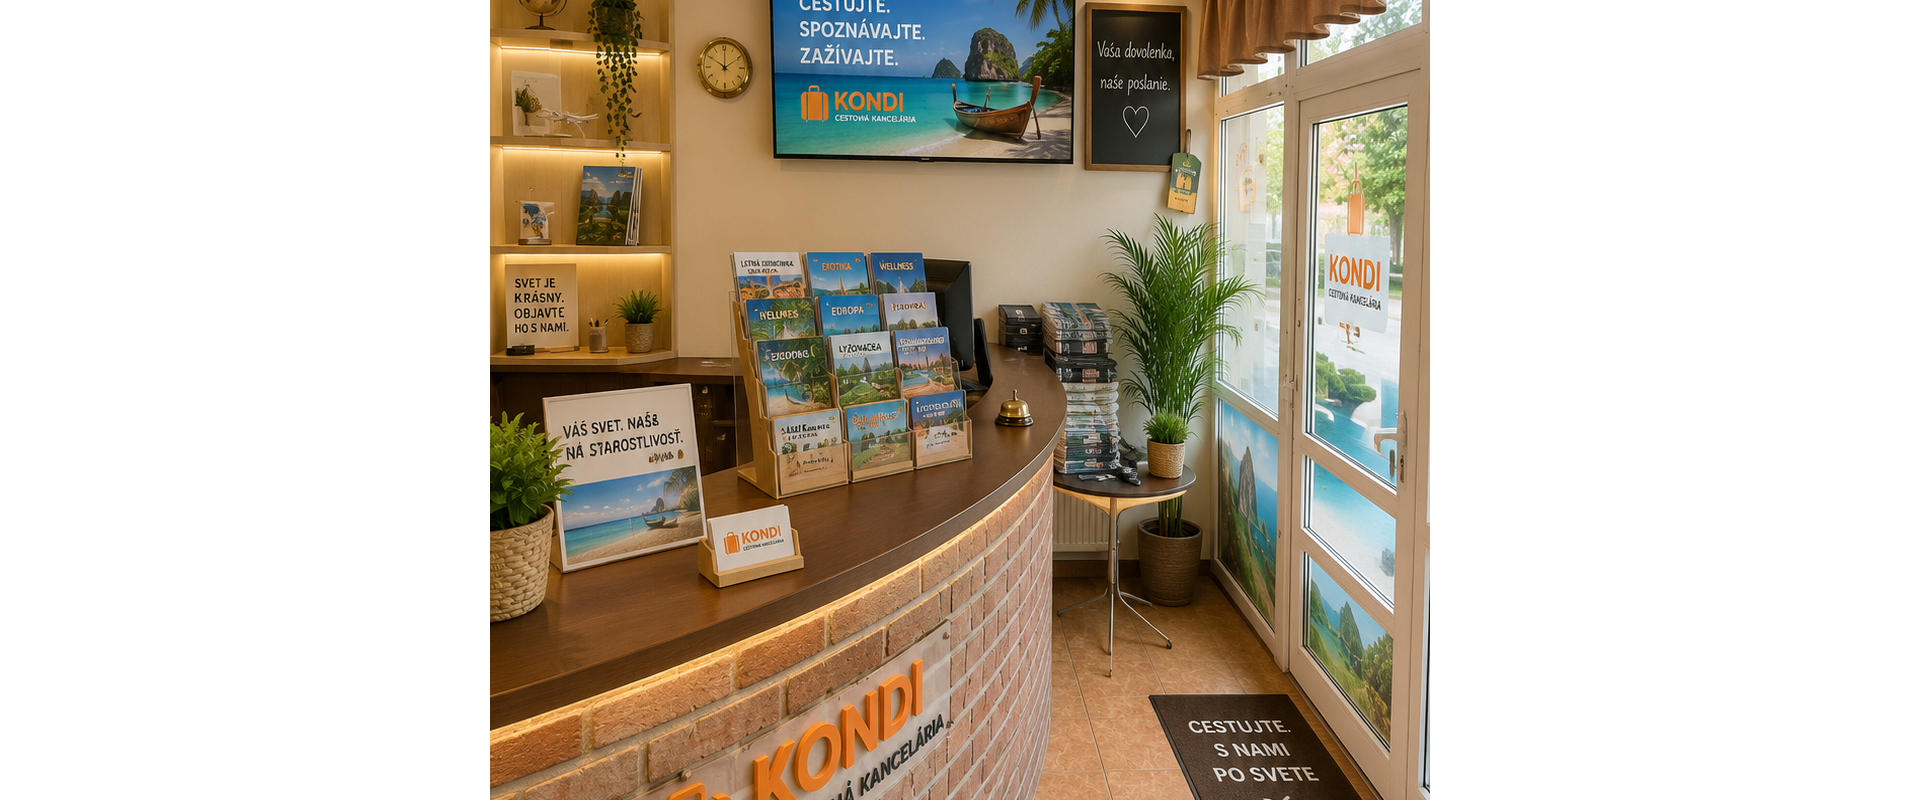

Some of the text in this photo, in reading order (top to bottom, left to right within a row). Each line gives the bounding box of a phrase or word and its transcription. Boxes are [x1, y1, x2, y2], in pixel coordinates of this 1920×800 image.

[799, 0, 890, 13] CESTUJTE.
[799, 18, 926, 40] SPOZNÁVAJTE.
[800, 44, 899, 66] ZAŽÍVAJTE.
[1124, 41, 1175, 62] dovolenka,
[1127, 73, 1171, 96] poslanie.
[834, 91, 904, 112] KONDI
[1329, 253, 1381, 292] KONDI
[514, 277, 556, 288] SVET JE
[514, 290, 565, 303] KRÁSNY.
[514, 306, 565, 319] OBJAVTE
[514, 321, 569, 334] HO S NAMI.
[591, 419, 624, 435] SVET.
[741, 525, 782, 544] KONDI
[754, 659, 923, 800] KONDI
[1188, 720, 1291, 734] CESTUJTE.
[860, 713, 945, 797] KANCELÁRIA
[1213, 743, 1291, 757] S NAMI
[1212, 766, 1320, 783] PO SVETE
